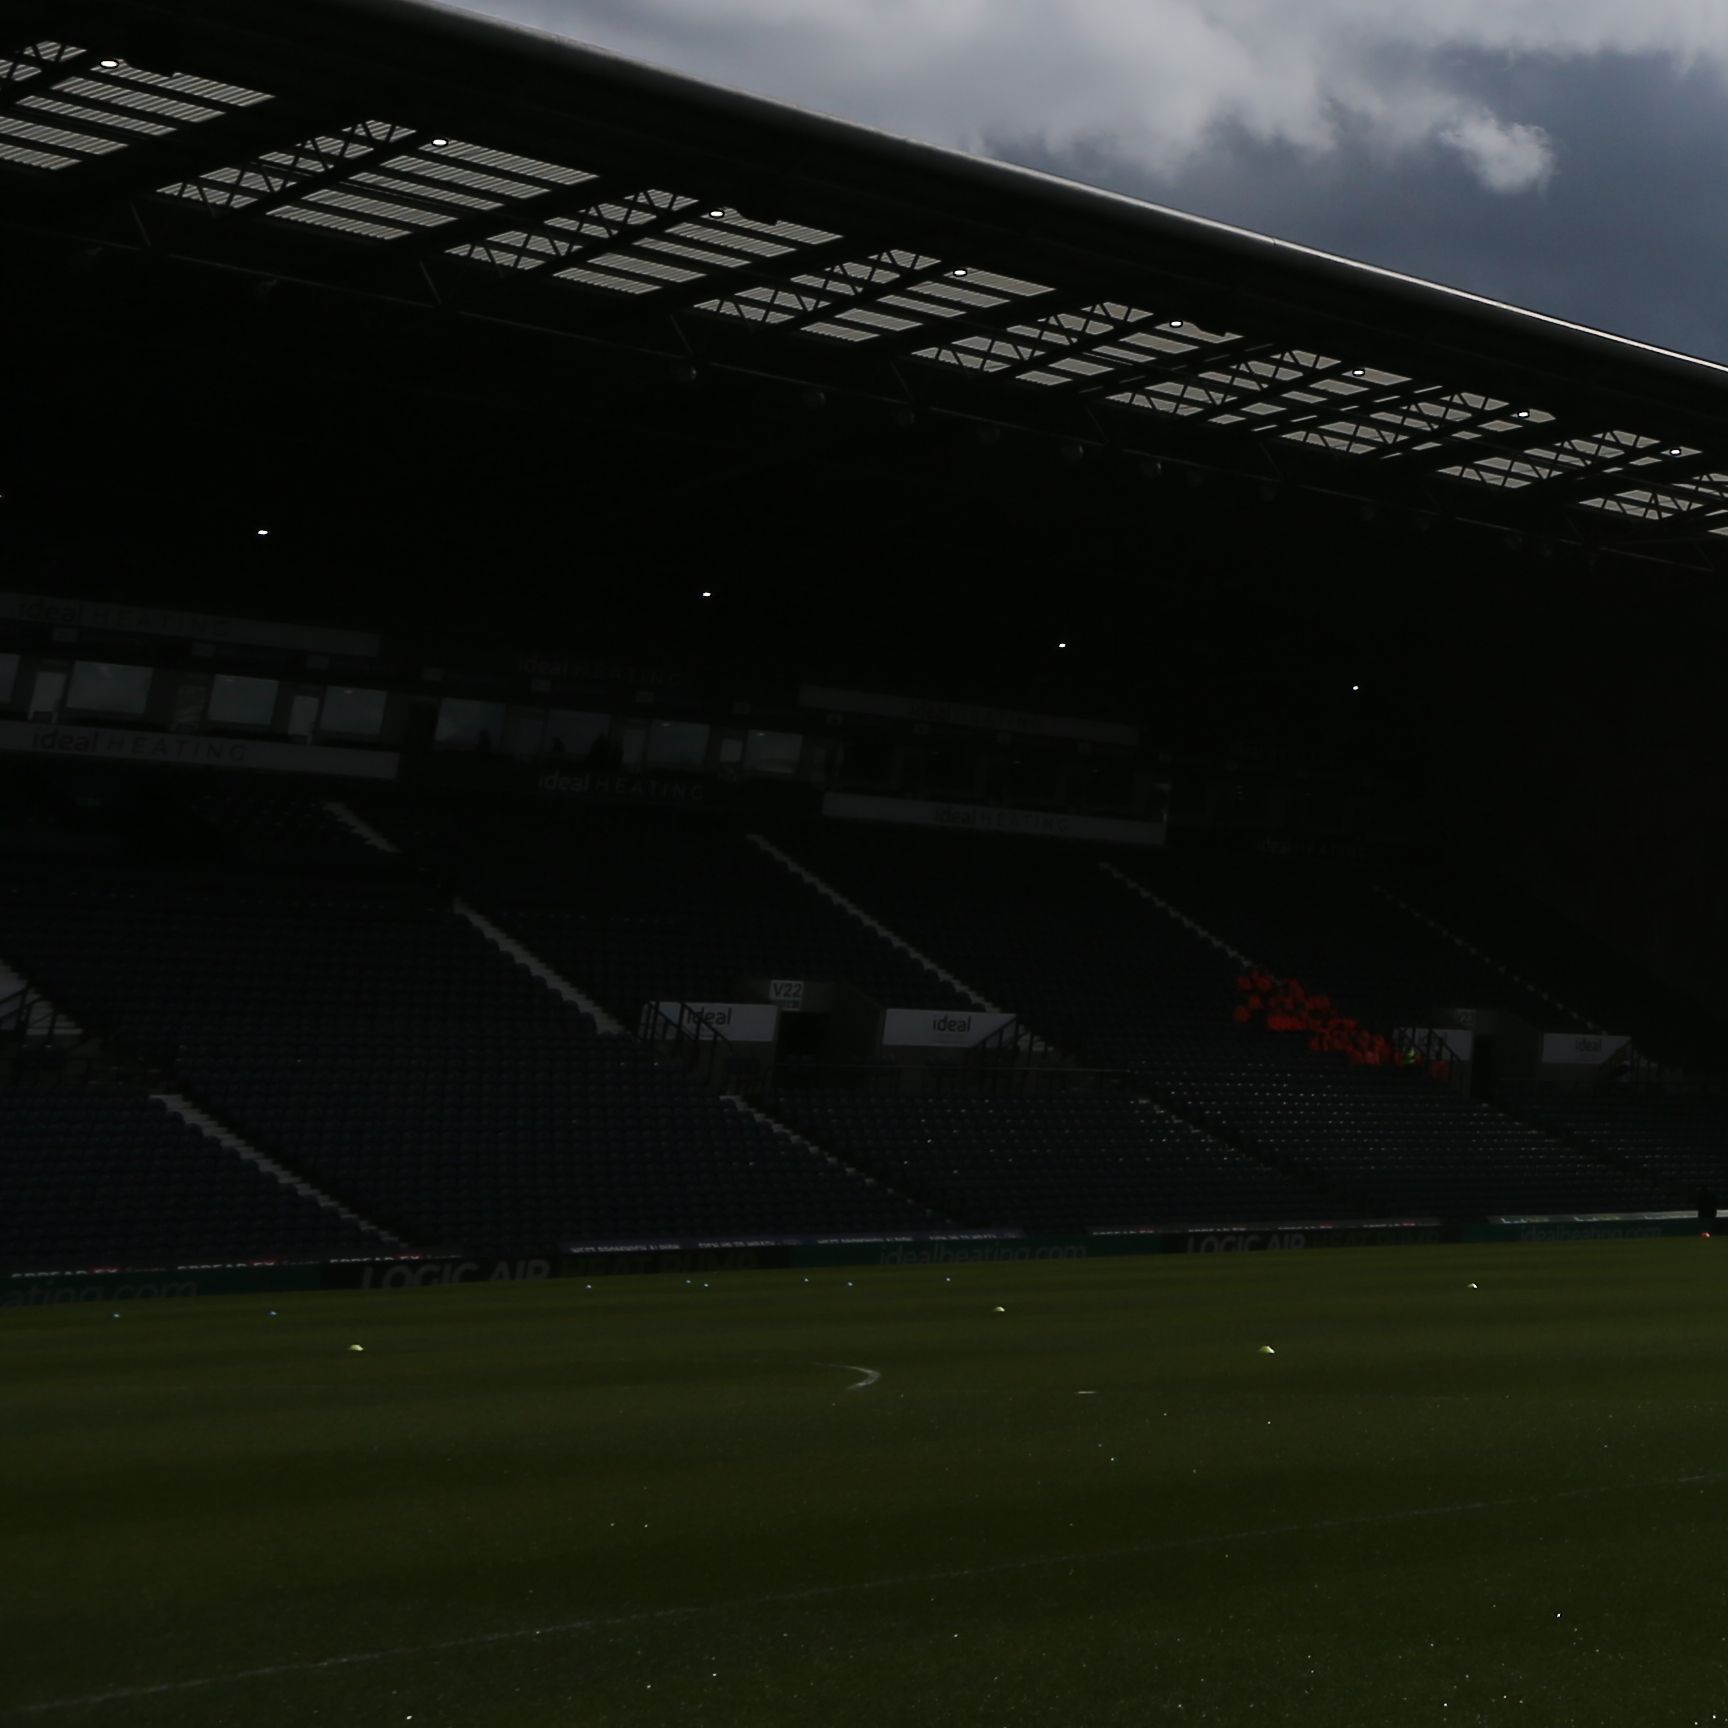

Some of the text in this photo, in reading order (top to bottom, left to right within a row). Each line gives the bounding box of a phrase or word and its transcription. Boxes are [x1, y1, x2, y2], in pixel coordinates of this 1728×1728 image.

[19, 597, 83, 624] ideal
[32, 728, 248, 763] ideal HEATING
[537, 769, 705, 802] ideal HEATING
[773, 982, 802, 997] V22
[686, 1008, 732, 1025] ideal
[932, 1013, 972, 1033] ideal
[879, 1241, 1088, 1265] idealheating.com
[1186, 1233, 1261, 1253] LOGIC
[1266, 1232, 1306, 1251] AIR
[361, 1261, 480, 1290] LOGIC
[489, 1258, 551, 1281] AIR
